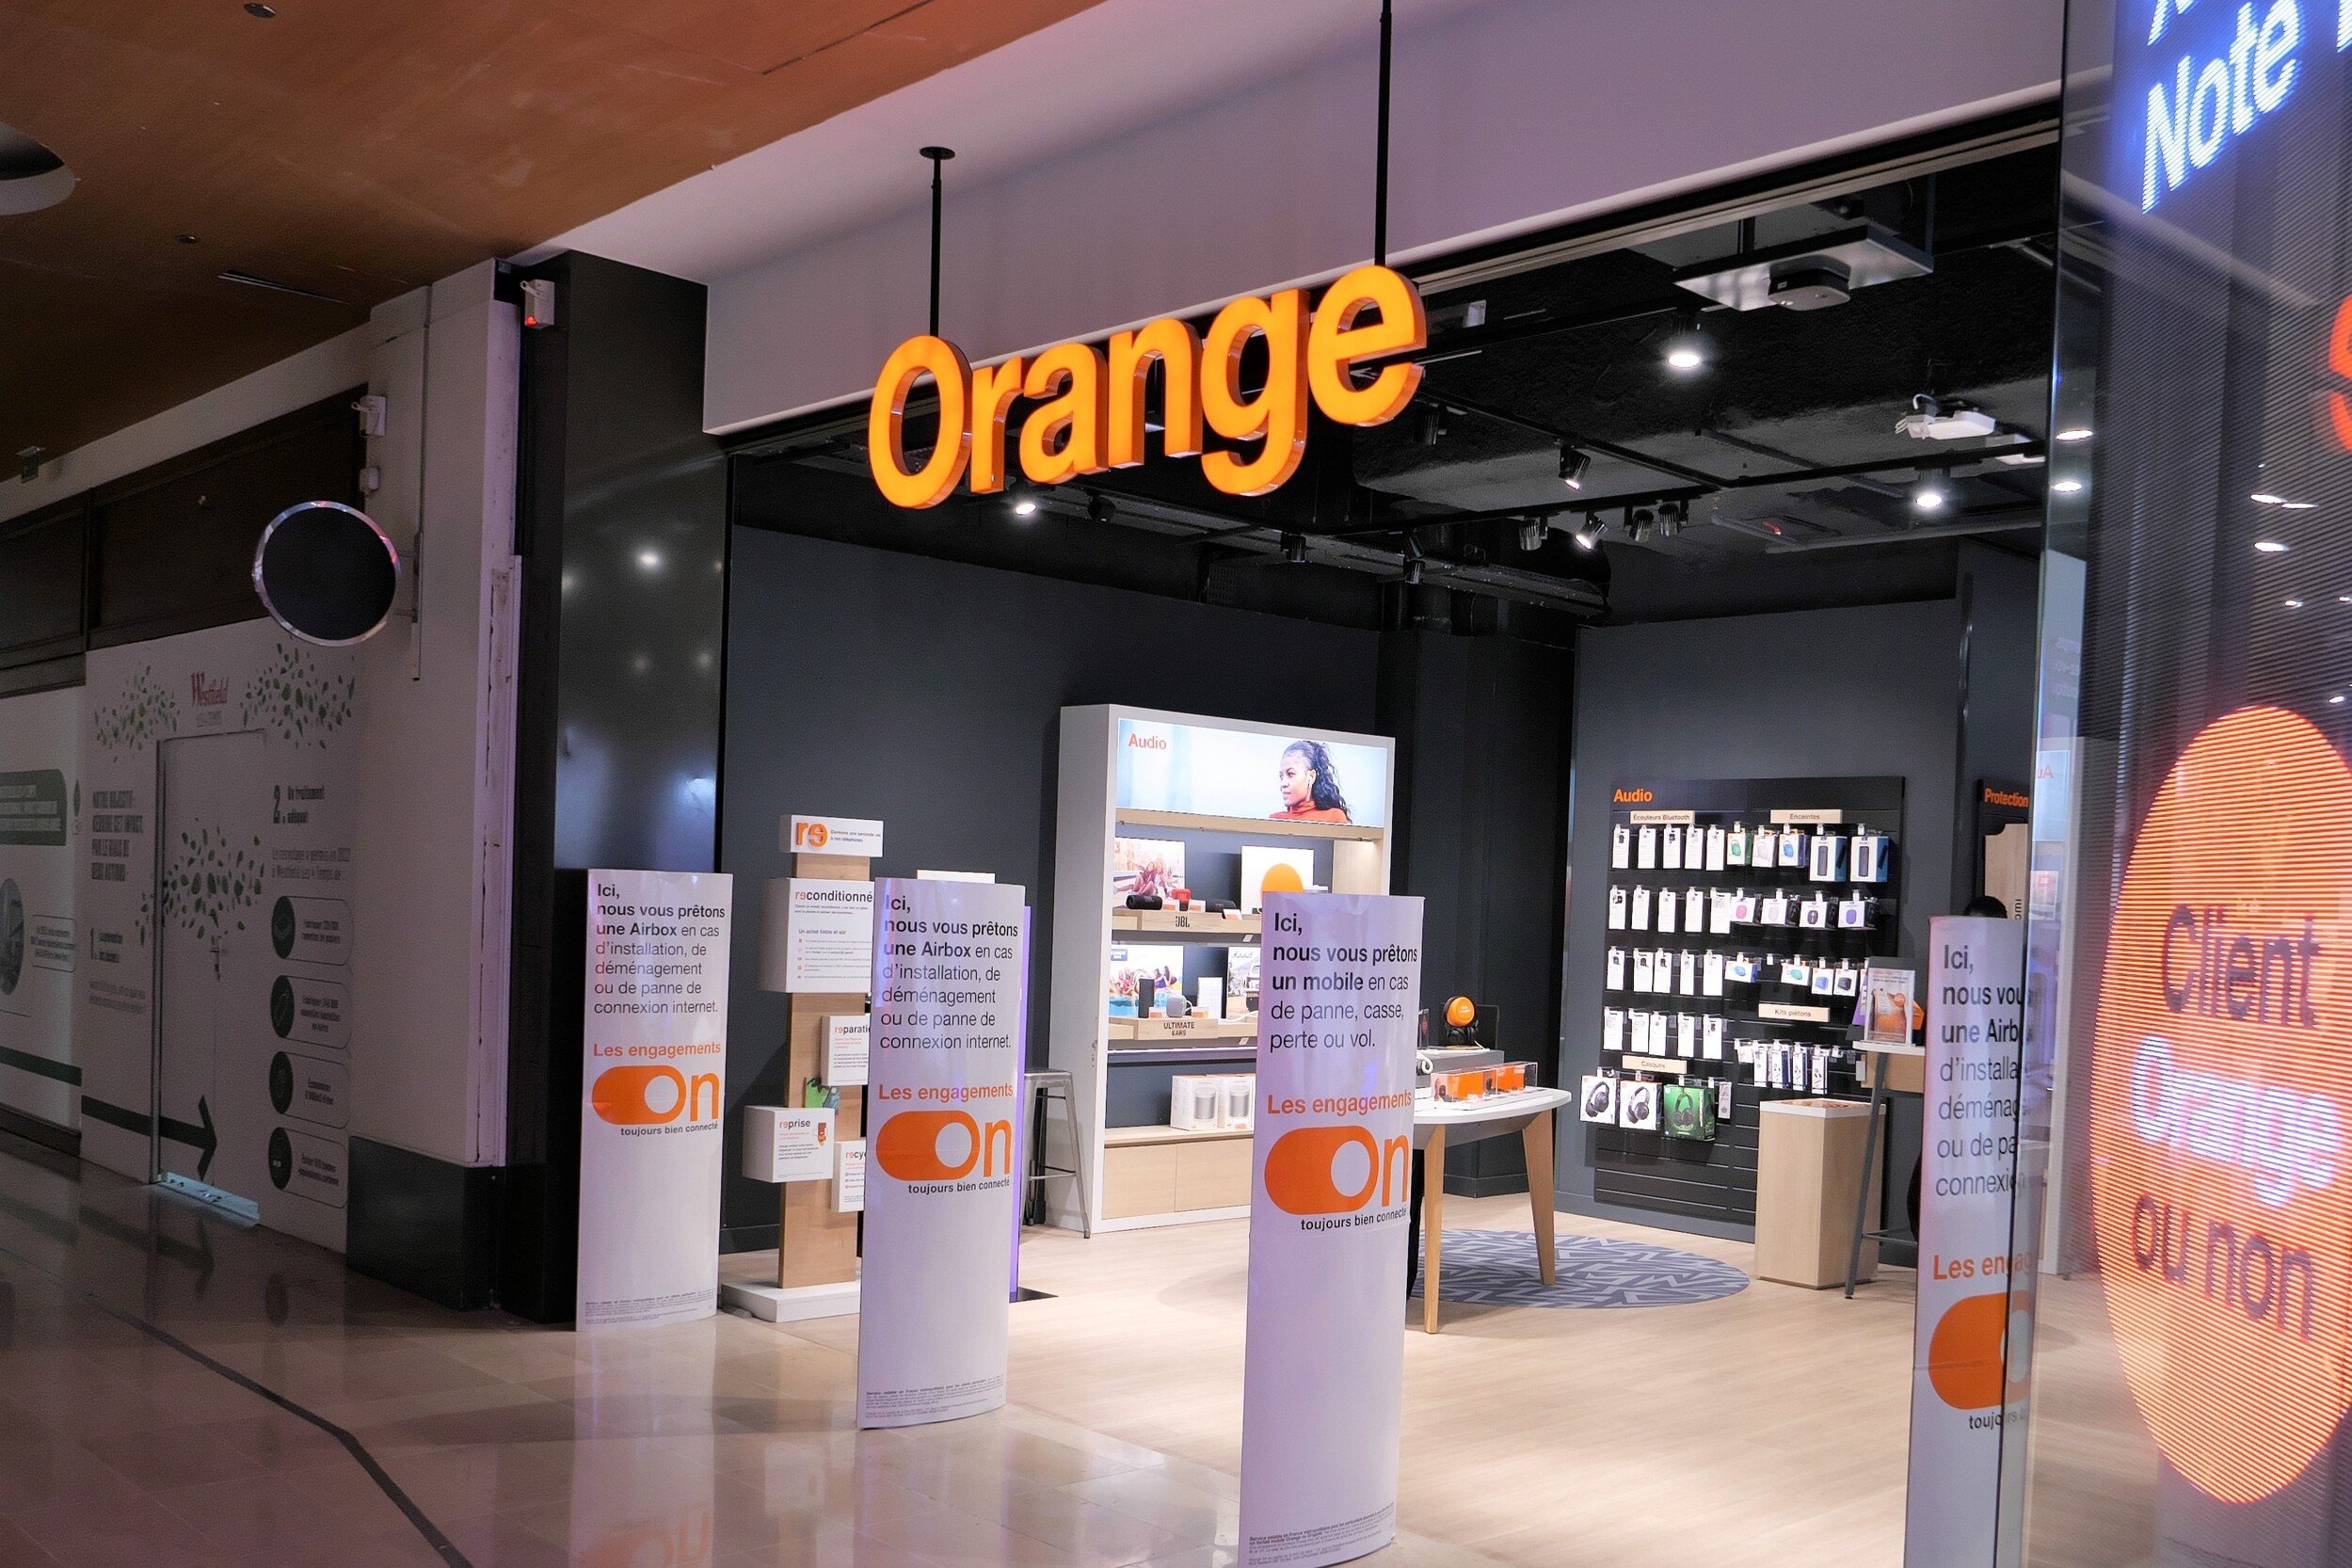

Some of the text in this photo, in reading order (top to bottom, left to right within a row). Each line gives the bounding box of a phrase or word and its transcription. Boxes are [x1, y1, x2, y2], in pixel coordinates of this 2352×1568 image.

[2142, 0, 2299, 215] Note
[868, 264, 1427, 510] Orange
[1128, 732, 1167, 750] Audio
[1613, 788, 1654, 803] Audio
[1984, 788, 2029, 808] Protection
[597, 883, 620, 900] Ici,
[794, 890, 873, 903] reconditionné
[597, 904, 726, 920] nous vous prêtons
[884, 895, 911, 913] Ici,
[596, 922, 720, 937] une Airbox en cas
[884, 920, 1018, 938] nous vous prêtons
[1176, 916, 1190, 928] JBL
[1274, 912, 1303, 936] Ici,
[691, 943, 707, 956] de
[884, 941, 1013, 959] une Airbox en cas
[1272, 944, 1417, 967] nous vous prêtons
[1944, 944, 1974, 973] Ici,
[595, 960, 702, 978] déménagement
[985, 967, 1000, 982] de
[2165, 904, 2321, 1028] Client
[594, 982, 702, 997] ou de panne de
[1272, 971, 1409, 991] un mobile en cas
[882, 987, 996, 1006] déménagement
[1943, 986, 2023, 1006] nous vou
[594, 1000, 718, 1015] connexion internet.
[1271, 1000, 1404, 1024] de panne, casse,
[1774, 1008, 1812, 1019] Kits piétons
[880, 1011, 996, 1029] ou de panne de
[1163, 1021, 1194, 1030] ULTIMATE
[835, 1025, 871, 1034] reparati
[1942, 1017, 2020, 1044] une Airb
[593, 1041, 721, 1059] Les engagements
[880, 1033, 1012, 1049] connexion internet.
[1270, 1029, 1375, 1053] perte ou vol.
[1640, 1061, 1666, 1070] Casques
[1940, 1056, 2018, 1082] d’installa
[592, 1064, 720, 1125] On
[878, 1082, 1014, 1103] Les engagements
[1268, 1089, 1412, 1117] Les engagements
[620, 1121, 718, 1137] toujours bien connecté
[779, 1119, 811, 1129] reprise
[2132, 1033, 2341, 1208] Orange
[876, 1110, 1012, 1181] On
[1937, 1138, 1963, 1159] ou
[1970, 1132, 1992, 1157] de
[1264, 1125, 1409, 1216] On
[908, 1178, 1010, 1195] toujours bien connecté
[1301, 1206, 1407, 1232] toujours bien connecté
[1933, 1255, 1975, 1279] Les
[2132, 1192, 2314, 1343] ou non
